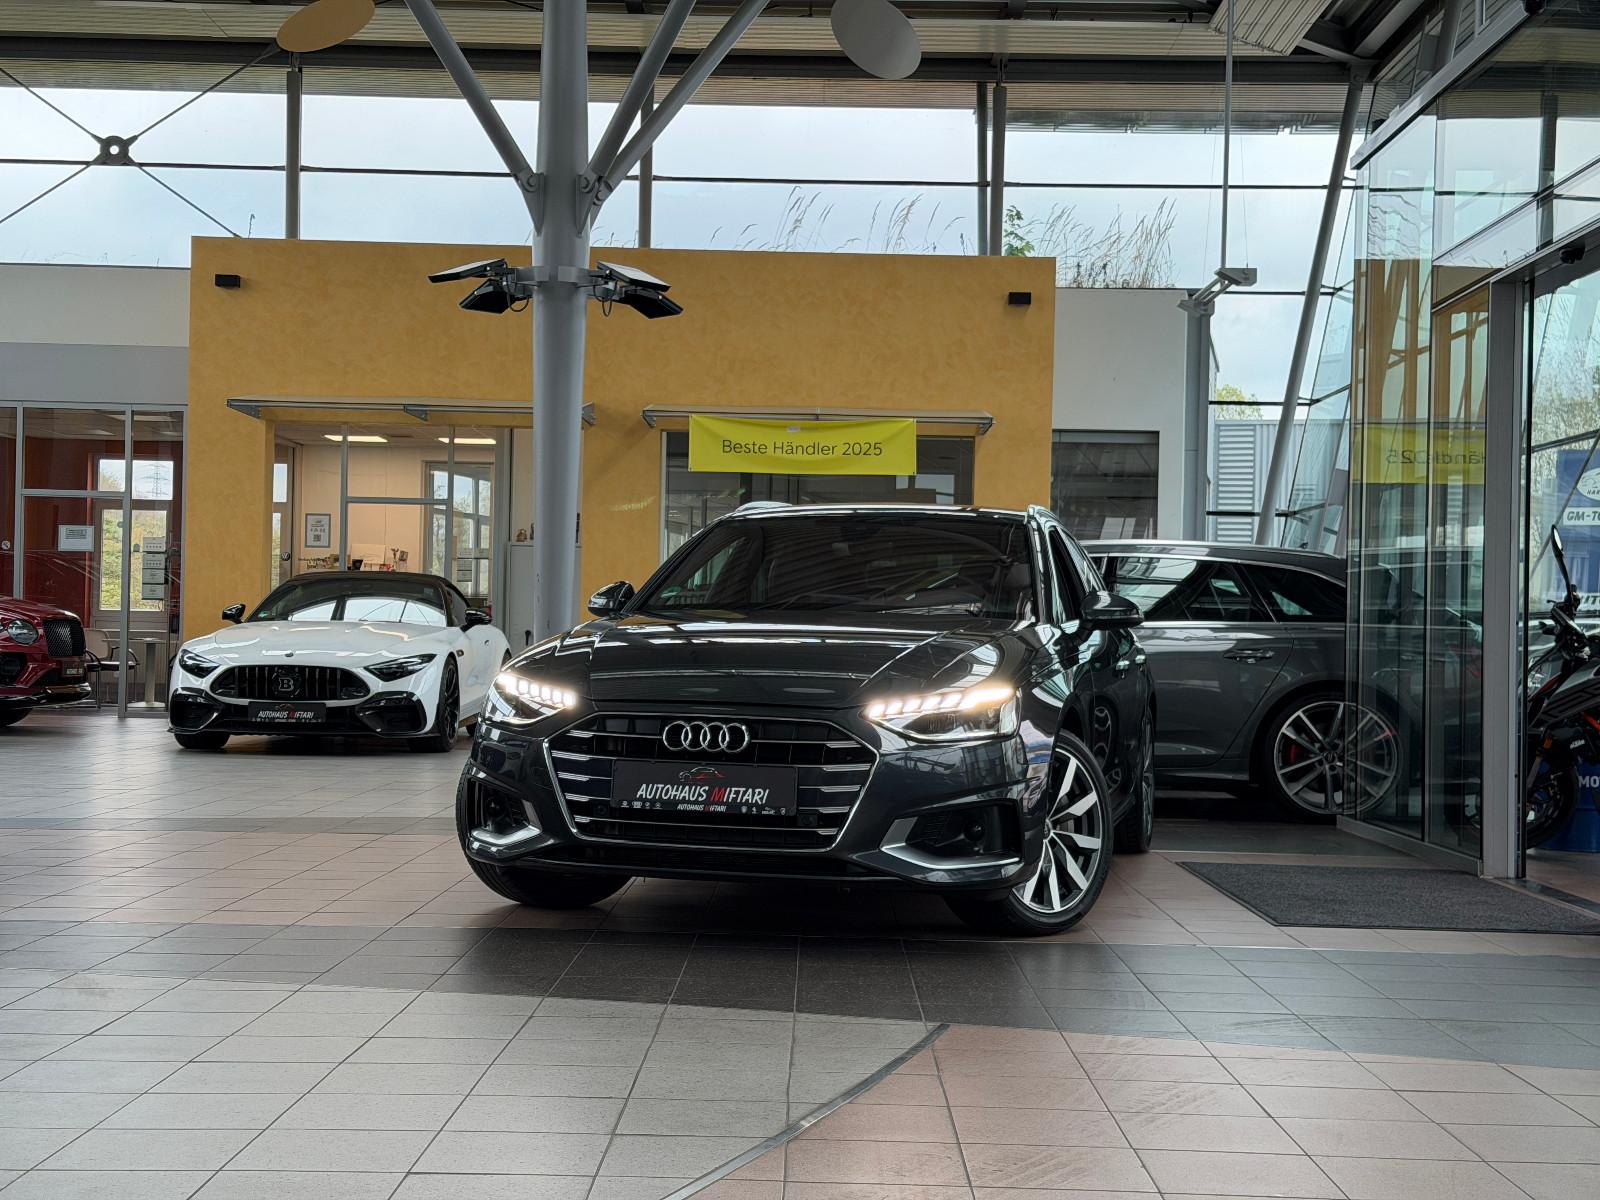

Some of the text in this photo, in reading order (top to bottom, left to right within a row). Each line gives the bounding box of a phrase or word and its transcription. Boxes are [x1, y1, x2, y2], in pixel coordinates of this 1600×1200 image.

[722, 439, 883, 456] Beste Händler 2025
[258, 710, 288, 718] AUTOHAUS
[1578, 775, 1600, 788] MO
[636, 783, 770, 805] AUTOHAUS MIFTARI
[677, 803, 704, 811] AUTOHAUS
